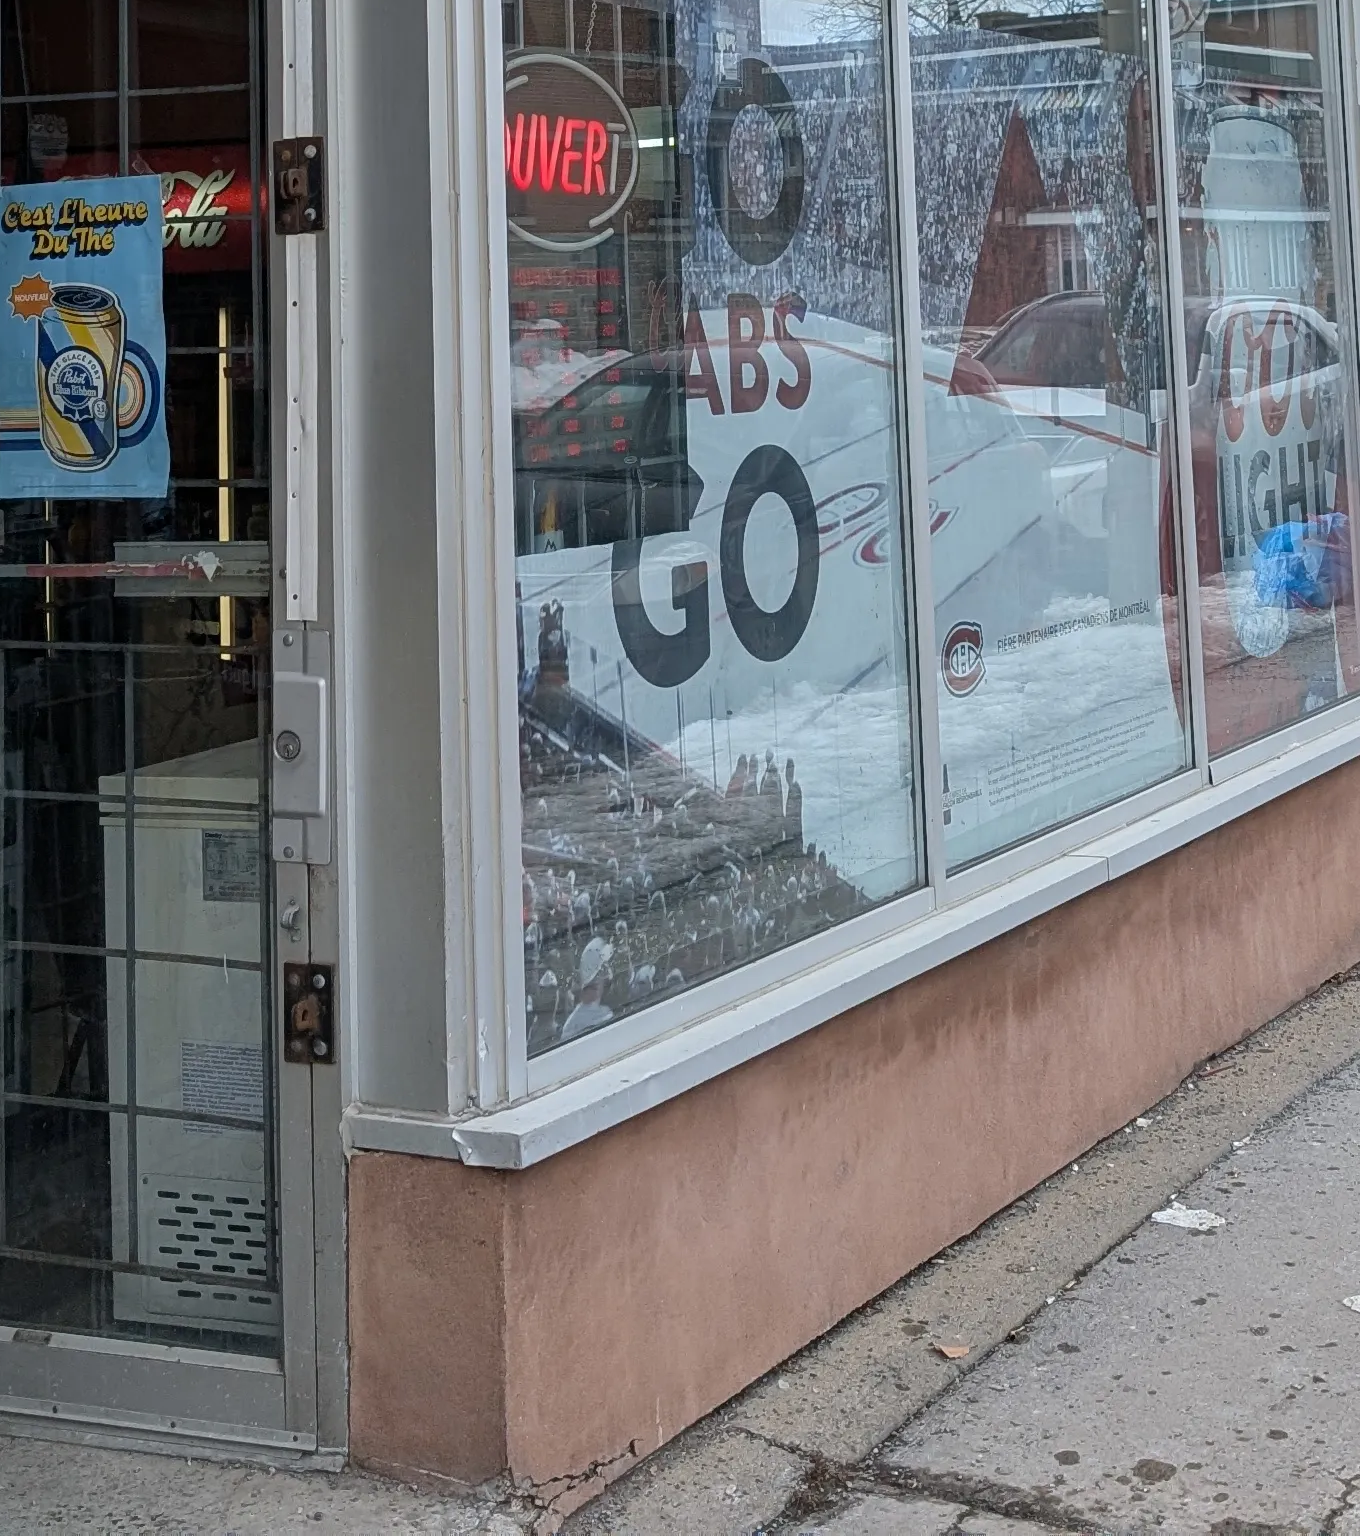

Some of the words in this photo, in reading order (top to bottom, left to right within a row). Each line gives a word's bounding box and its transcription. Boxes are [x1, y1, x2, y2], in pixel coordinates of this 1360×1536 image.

[505, 112, 627, 196] UVERT
[4, 200, 54, 228] C'est
[57, 198, 148, 226] L'heure
[33, 231, 69, 255] Du
[71, 227, 114, 252] Thé
[14, 292, 49, 303] NOUVEAU
[648, 279, 812, 416] ABS
[62, 368, 87, 384] Pabst
[612, 444, 820, 688] GO
[997, 632, 1017, 653] FIÈRE
[1017, 624, 1059, 647] PARTENAIRE
[1058, 619, 1072, 634] DES
[1109, 607, 1118, 622] DE
[1118, 599, 1151, 621] MONTRÉAL
